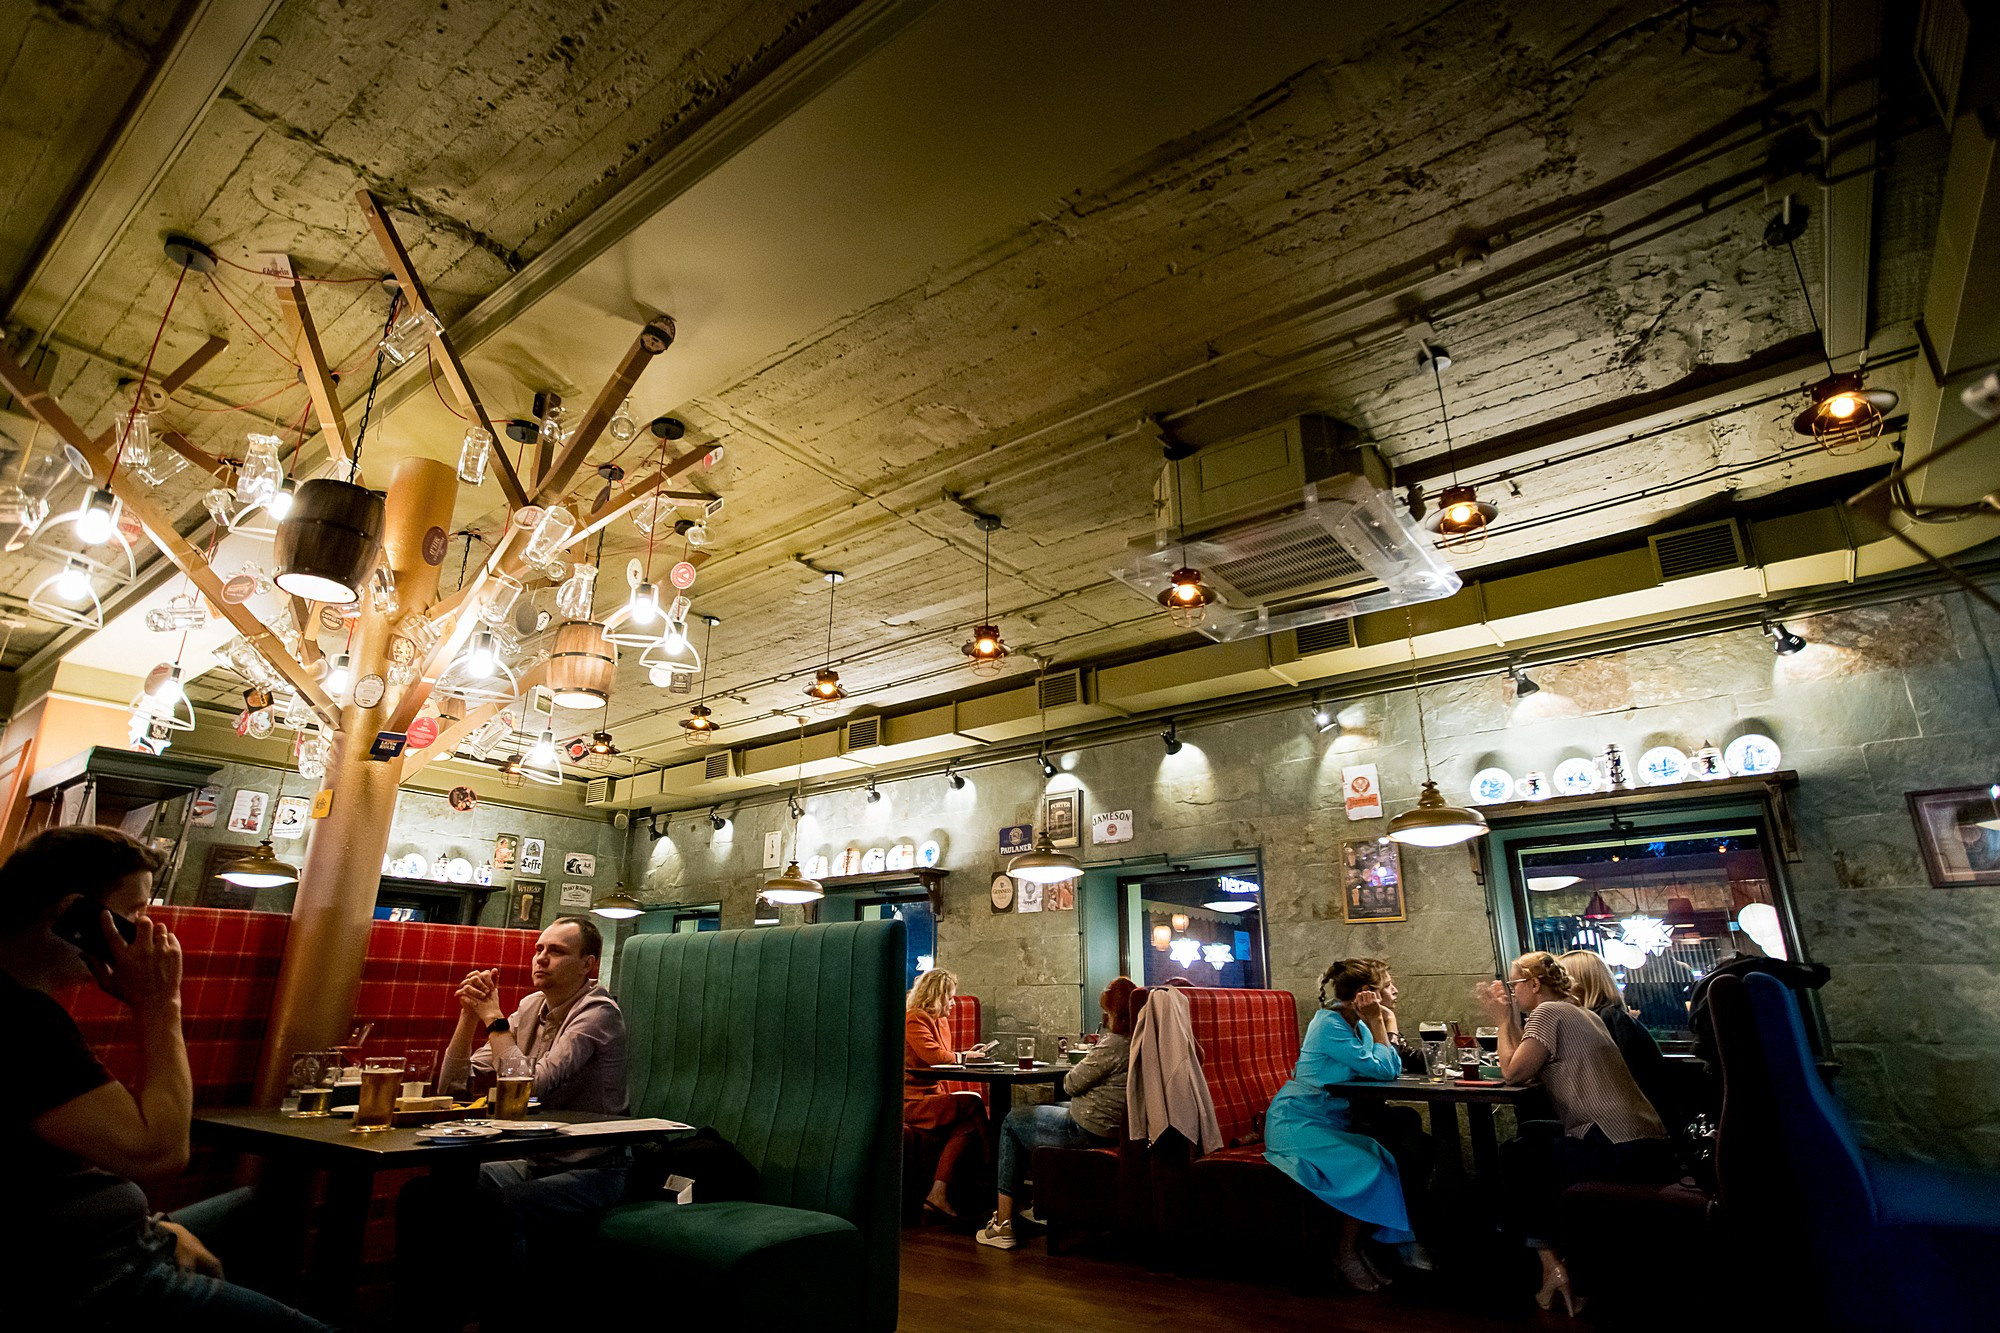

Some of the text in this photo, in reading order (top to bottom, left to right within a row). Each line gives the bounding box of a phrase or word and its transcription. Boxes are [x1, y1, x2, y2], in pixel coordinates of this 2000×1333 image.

[1050, 800, 1071, 810] PORTER
[1092, 812, 1131, 826] JAMESON
[1000, 843, 1033, 855] PAULANER
[521, 857, 541, 871] Leffe
[992, 887, 1012, 895] GUINNESS
